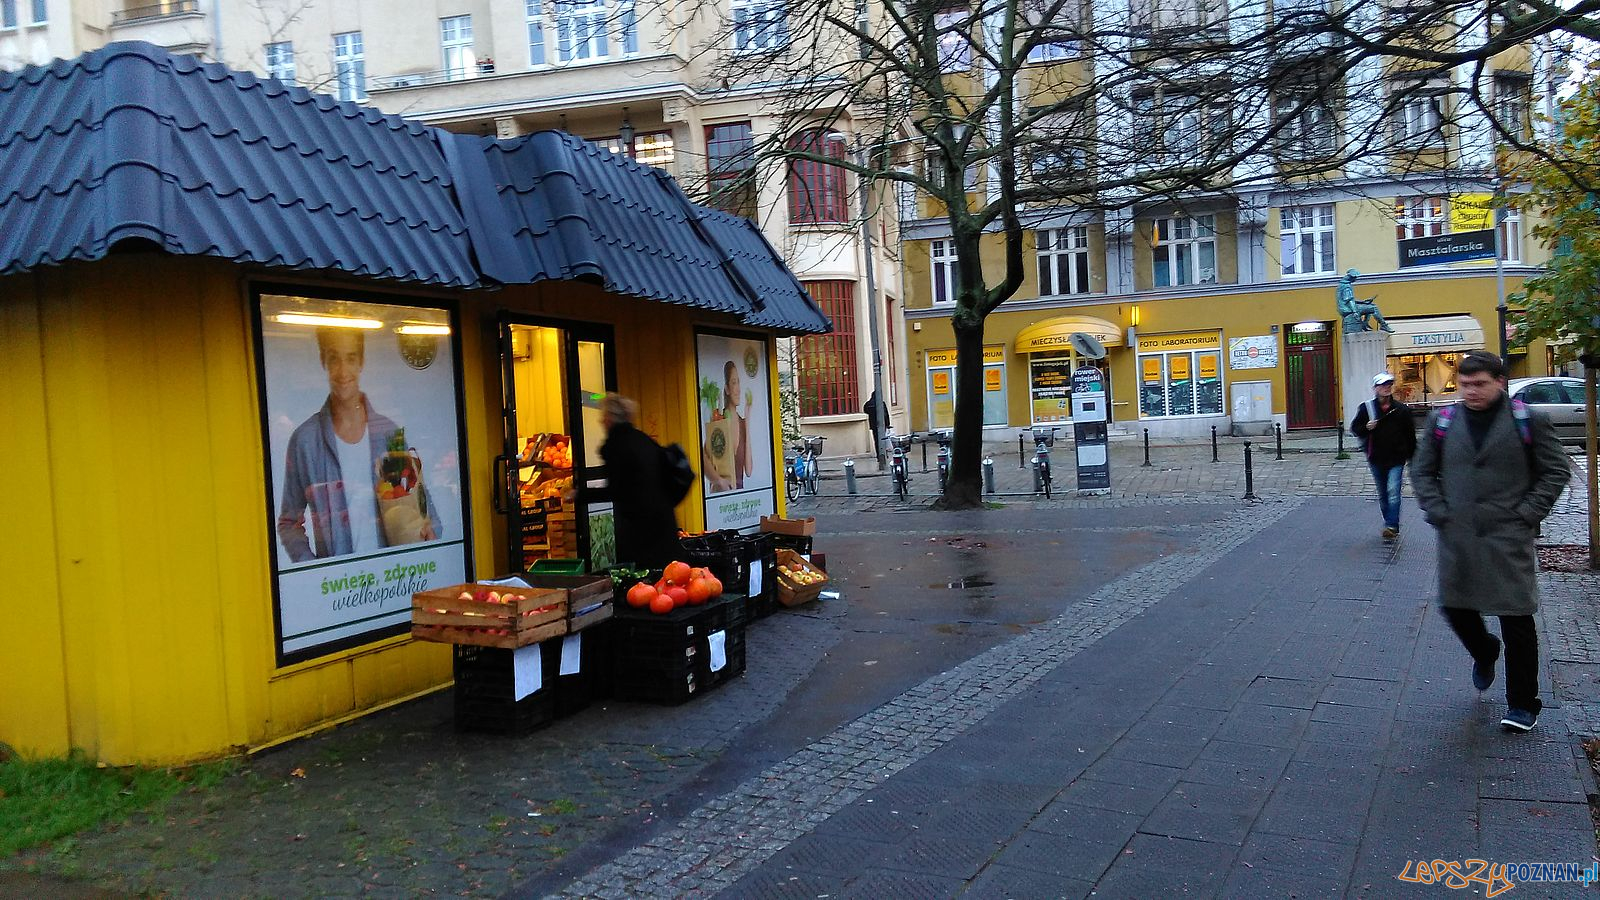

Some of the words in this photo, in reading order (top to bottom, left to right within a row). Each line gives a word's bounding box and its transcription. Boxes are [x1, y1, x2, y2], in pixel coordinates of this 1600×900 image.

[1408, 242, 1483, 258] Masztalarska
[1162, 336, 1218, 347] LABORATORIUM
[1411, 332, 1465, 345] TEKSTYLIA
[1074, 374, 1101, 383] miejski
[321, 570, 380, 595] świeże,
[384, 560, 437, 583] zdrowe
[332, 572, 428, 611] wielkopolskie
